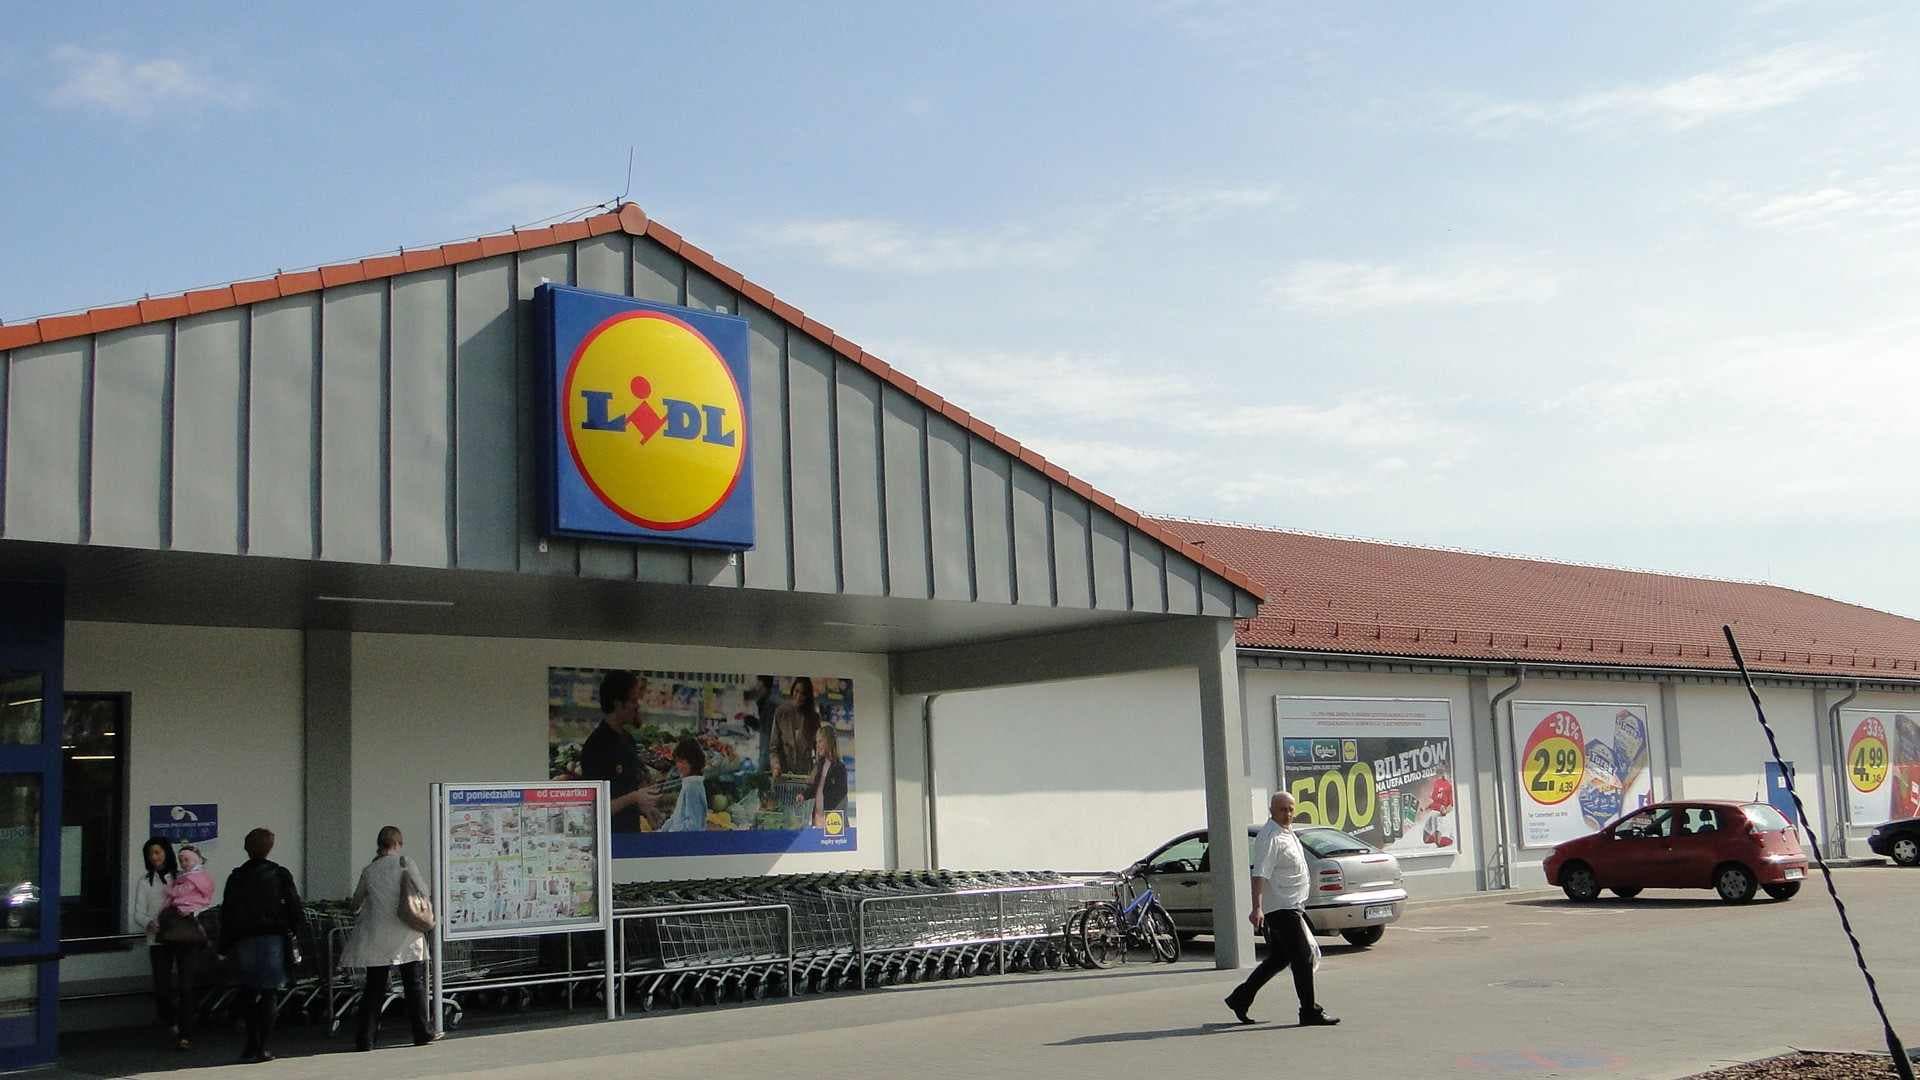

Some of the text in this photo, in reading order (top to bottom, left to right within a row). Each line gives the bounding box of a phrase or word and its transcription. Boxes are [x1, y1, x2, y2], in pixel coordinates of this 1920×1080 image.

[1549, 713, 1580, 740] -31%
[1374, 740, 1448, 781] BILETÓW
[536, 788, 588, 798] od czwartku
[1375, 781, 1387, 792] NA
[1386, 775, 1404, 789] UEFA
[1403, 771, 1422, 784] EURO
[452, 789, 521, 801] od poniedziałku
[1291, 761, 1376, 830] 500
